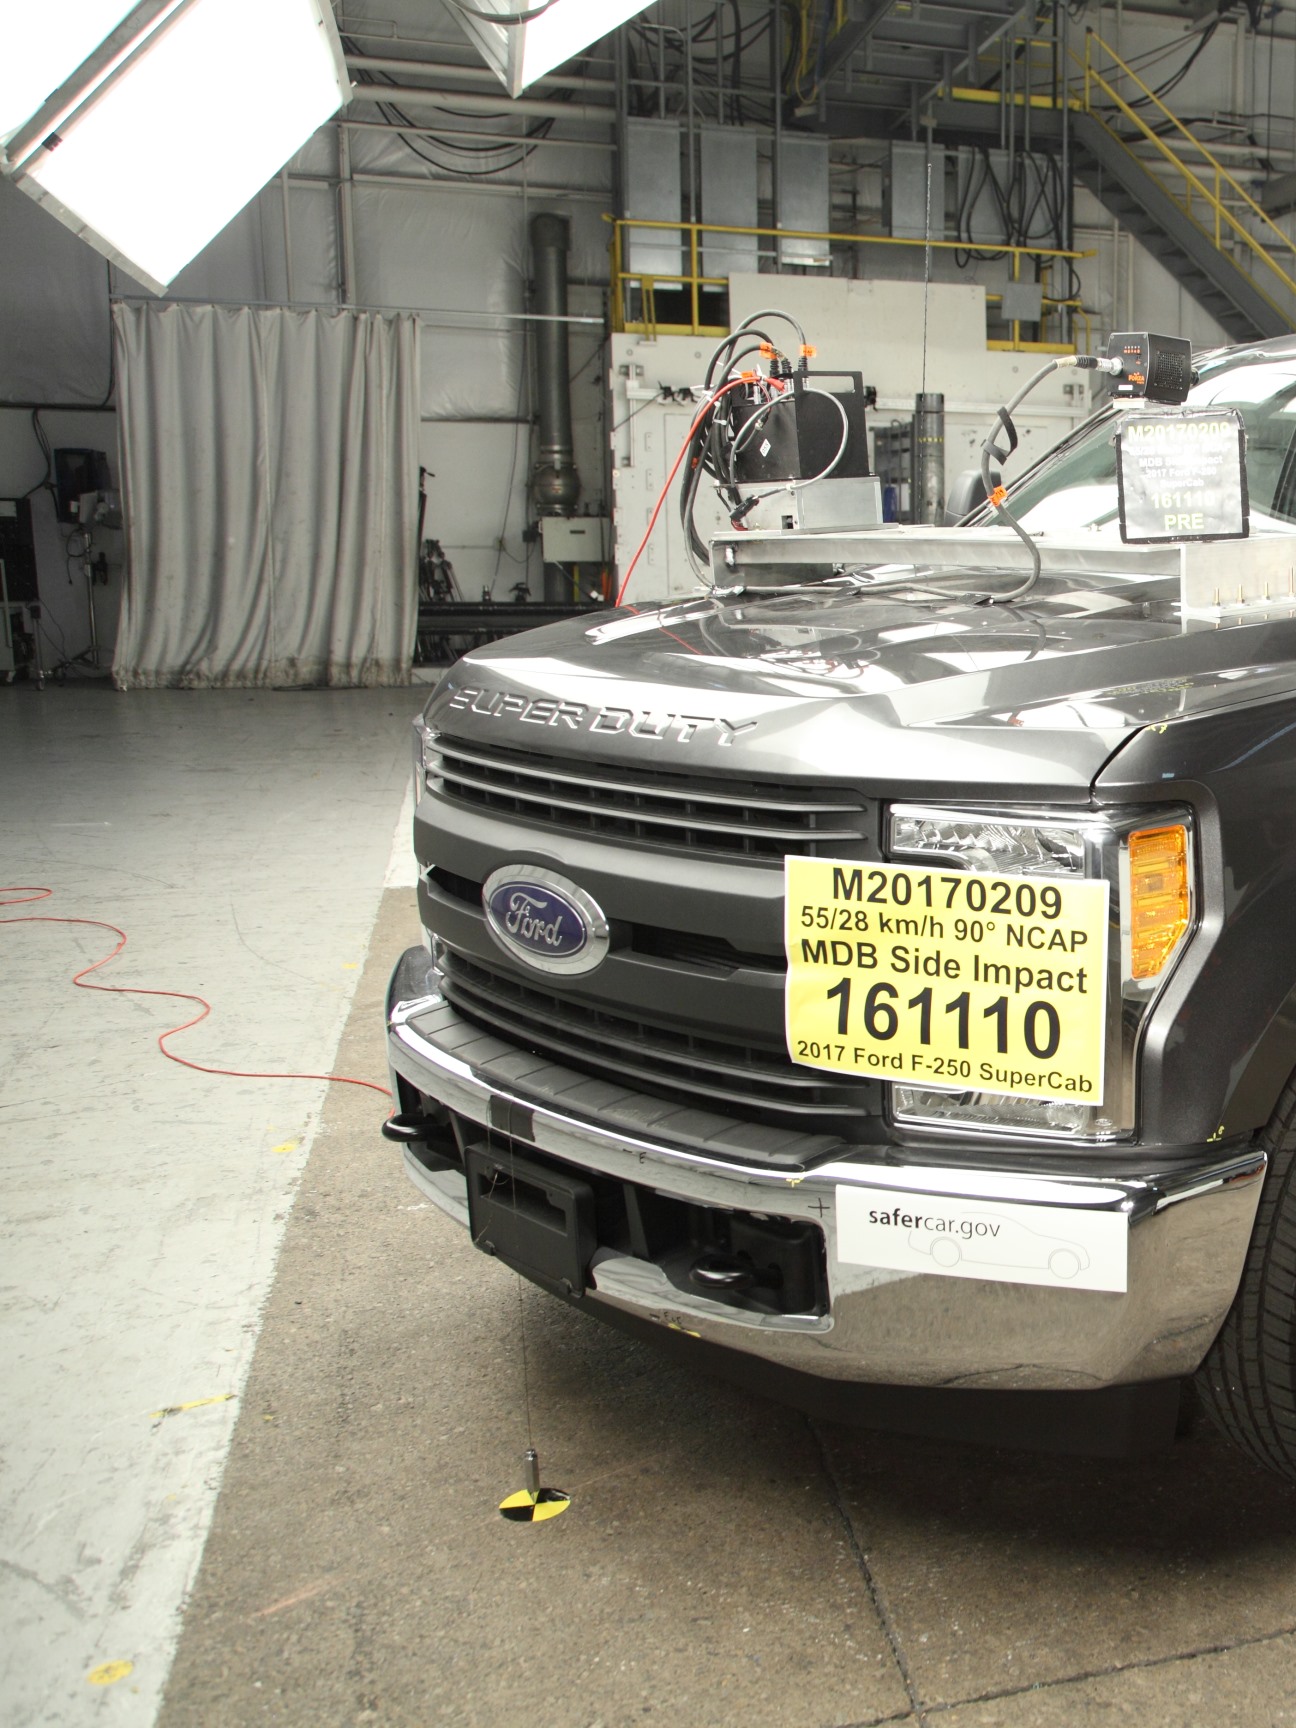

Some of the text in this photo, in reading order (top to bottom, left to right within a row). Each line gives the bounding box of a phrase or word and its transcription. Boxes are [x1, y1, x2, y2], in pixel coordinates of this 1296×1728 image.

[1127, 421, 1231, 443] M20170209
[1151, 491, 1216, 509] 161110
[1163, 512, 1205, 531] PRE
[450, 686, 758, 747] SUPER DUTY
[832, 867, 1062, 919] M20170209
[505, 892, 563, 947] Ford
[801, 905, 1088, 953] 55/28 km/h 90° NCAP
[801, 938, 1088, 994] MDB Side Impact
[826, 977, 1061, 1059] 161110
[797, 1040, 1093, 1093] 2017 Ford F-250 SuperCab
[869, 1208, 1001, 1239] safercar.gov
